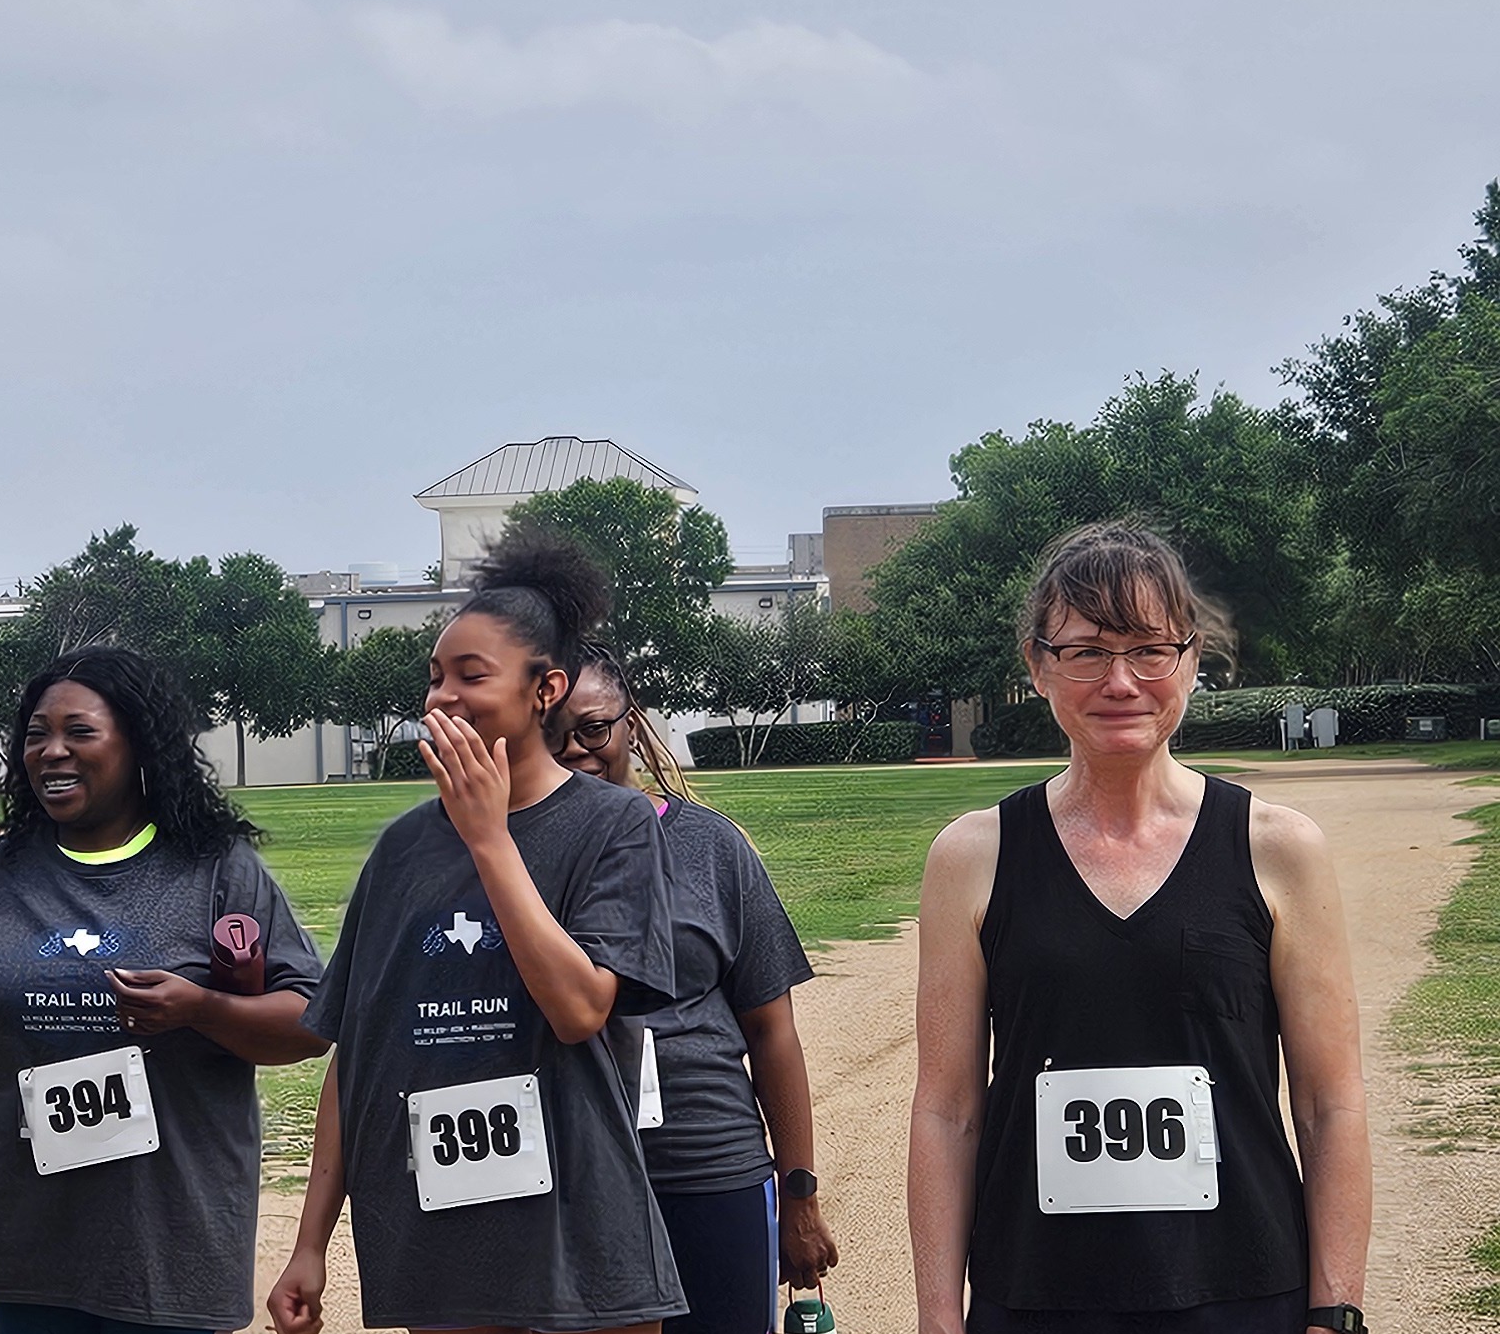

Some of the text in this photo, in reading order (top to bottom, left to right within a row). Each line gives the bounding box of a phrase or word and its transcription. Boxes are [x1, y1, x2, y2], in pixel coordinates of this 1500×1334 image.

[24, 992, 117, 1007] TRAIL RUN
[417, 997, 509, 1019] TRAIL RUN
[45, 1073, 132, 1134] 394
[1064, 1097, 1187, 1163] 396
[429, 1103, 522, 1166] 398
